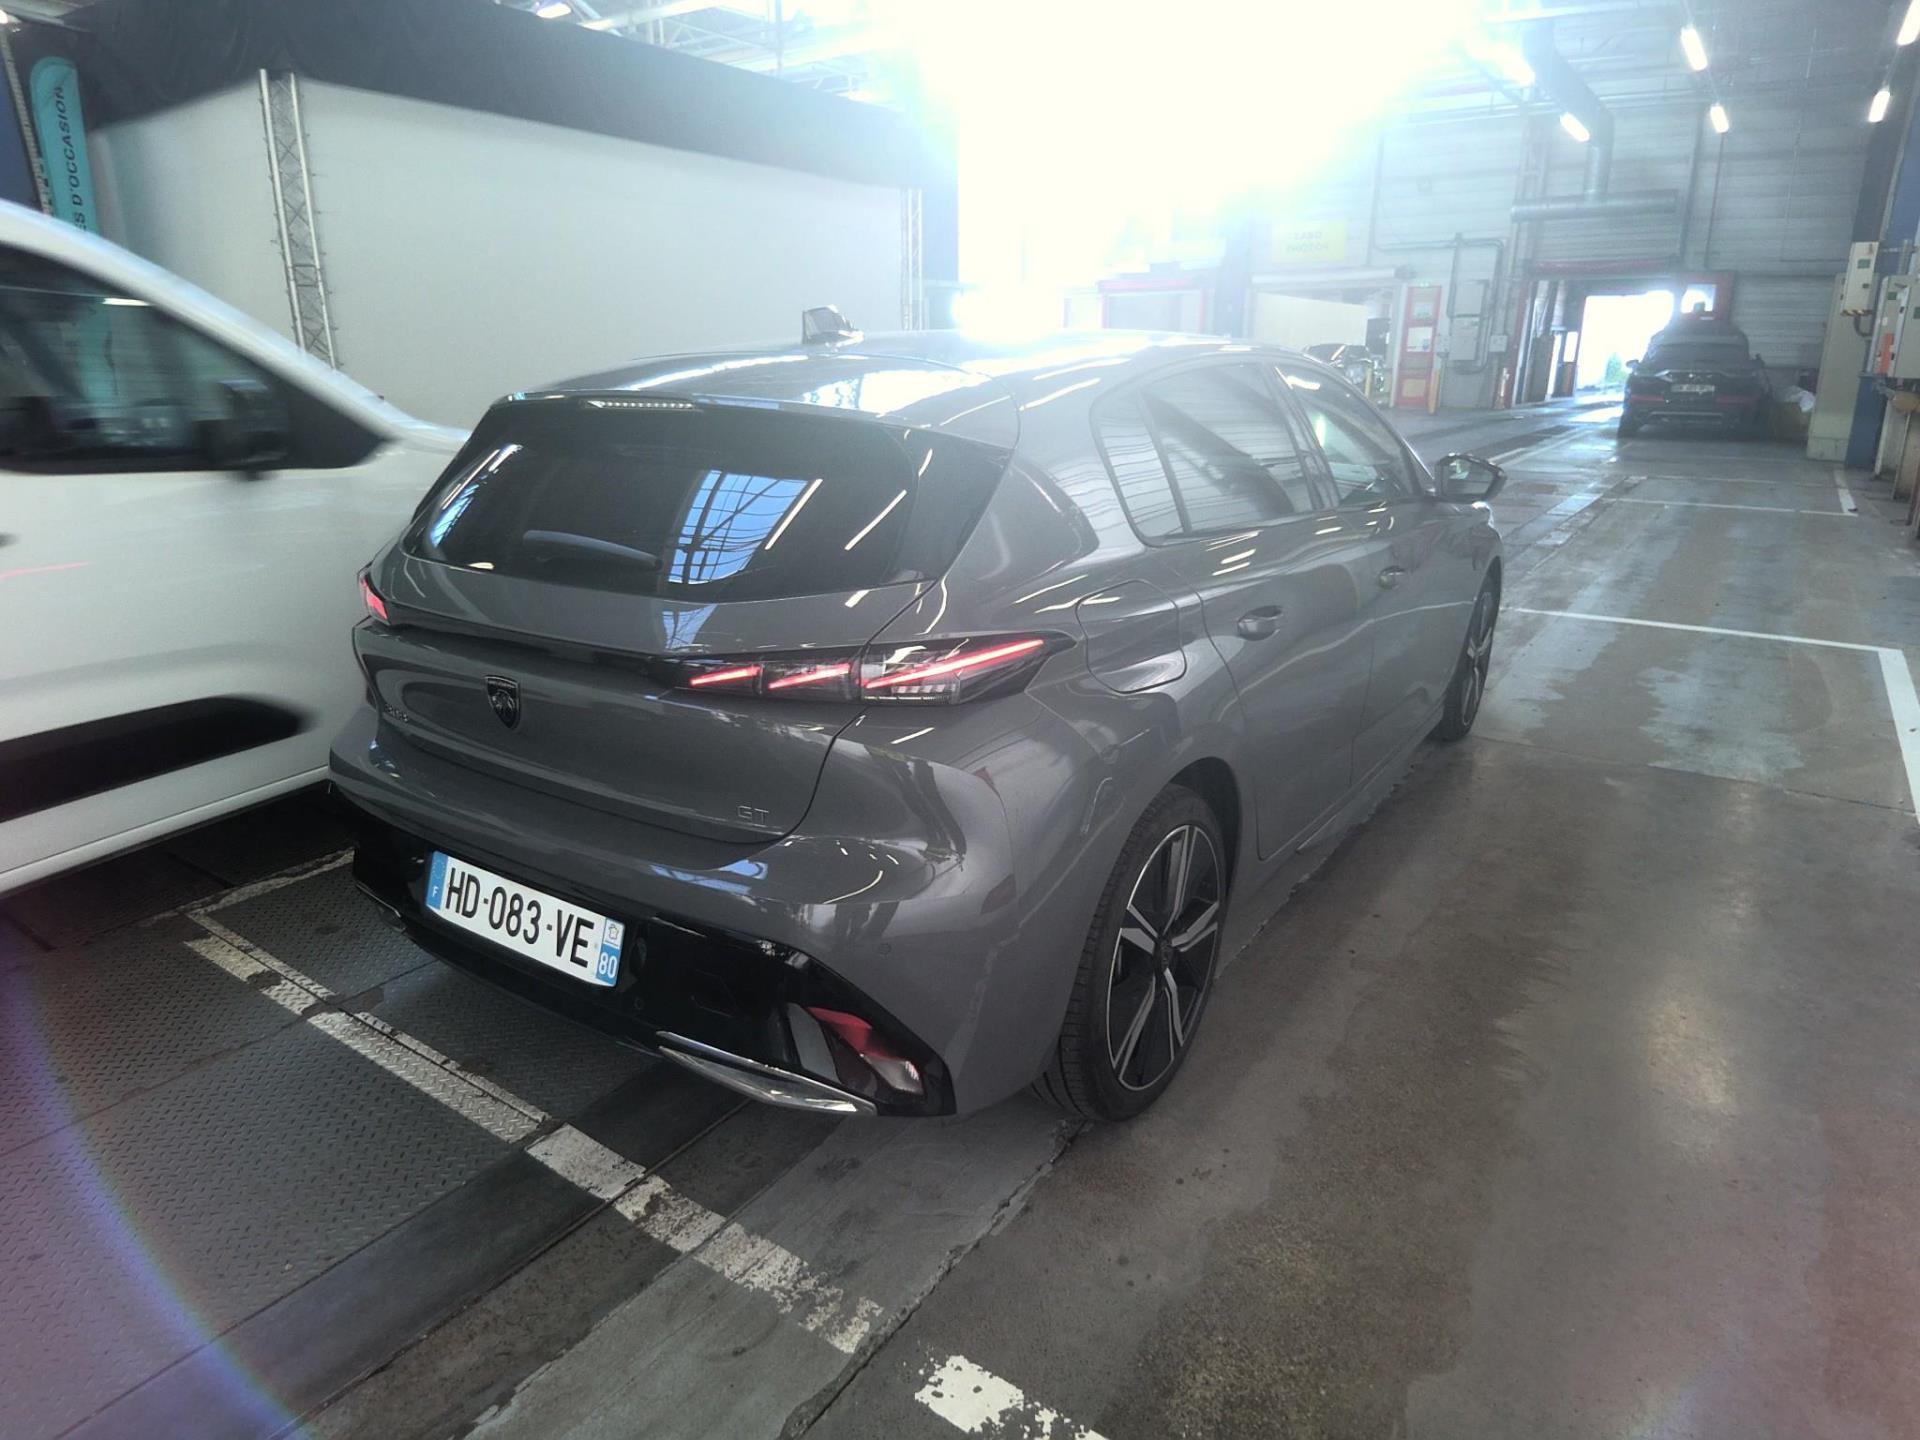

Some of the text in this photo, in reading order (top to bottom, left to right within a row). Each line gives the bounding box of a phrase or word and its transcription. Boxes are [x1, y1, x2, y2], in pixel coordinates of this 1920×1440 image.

[54, 86, 84, 206] D'OCCASION
[737, 805, 769, 825] GT
[432, 886, 439, 897] F
[445, 868, 595, 968] HD-083-VE
[599, 952, 618, 978] 80
